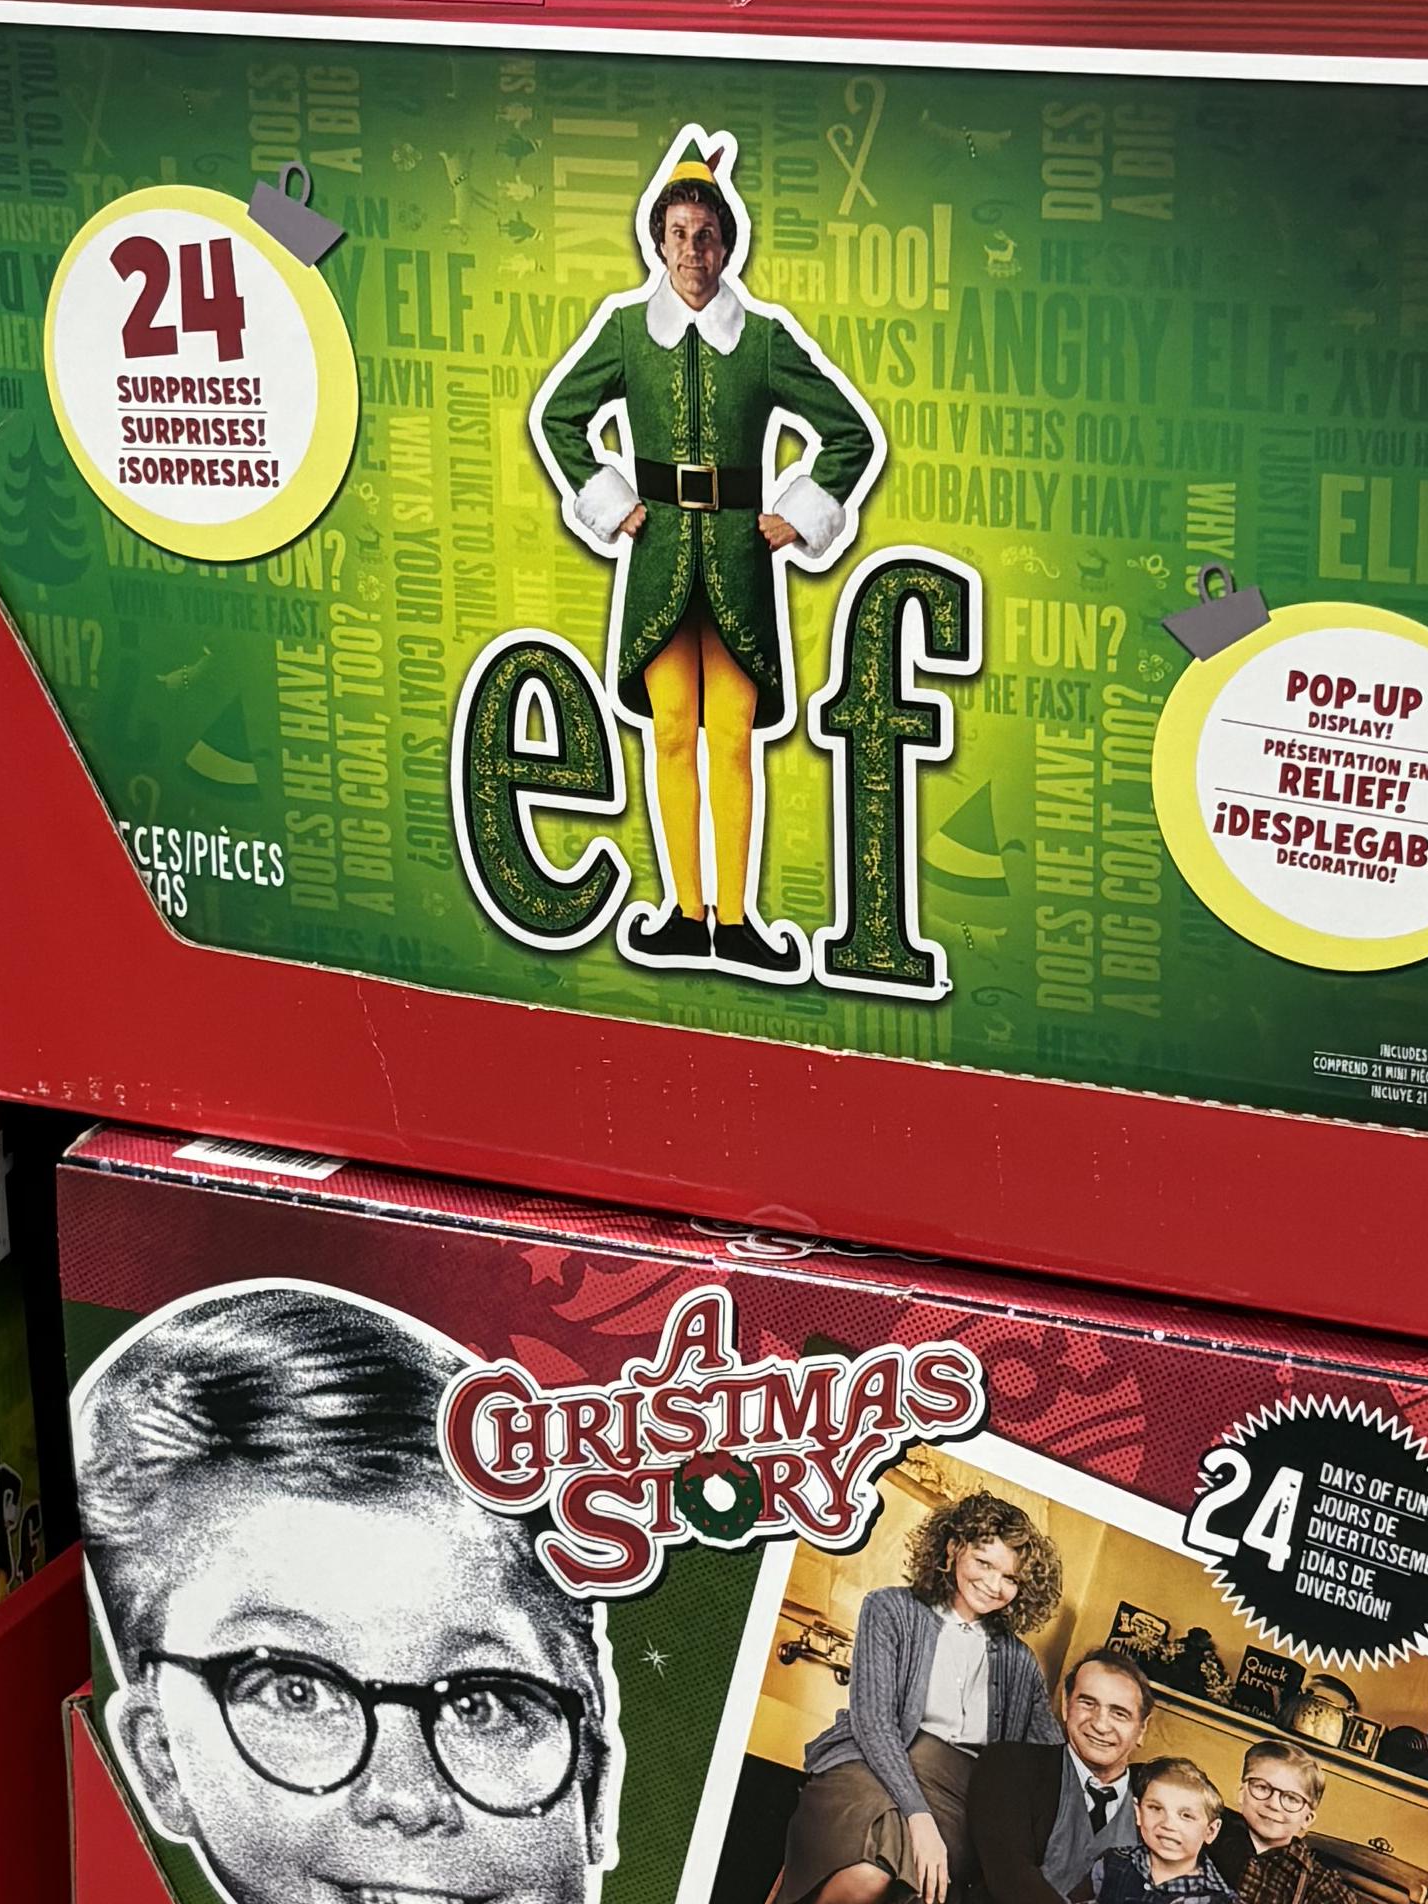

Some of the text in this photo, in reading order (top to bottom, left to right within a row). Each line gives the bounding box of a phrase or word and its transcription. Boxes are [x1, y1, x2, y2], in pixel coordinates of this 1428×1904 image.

[109, 235, 246, 362] 24
[116, 375, 262, 408] SURPRISES!
[121, 417, 267, 447] SURPRISES!
[118, 455, 281, 489] ¡SORPRESAS!
[1286, 669, 1423, 720] POP-UP
[1279, 763, 1411, 814] RELIEF!
[1380, 1044, 1427, 1063] INCLUDES
[652, 1295, 736, 1391] A
[446, 1348, 982, 1505] CHRISTMAS
[546, 1444, 882, 1585] STORY
[1187, 1448, 1304, 1572] 24
